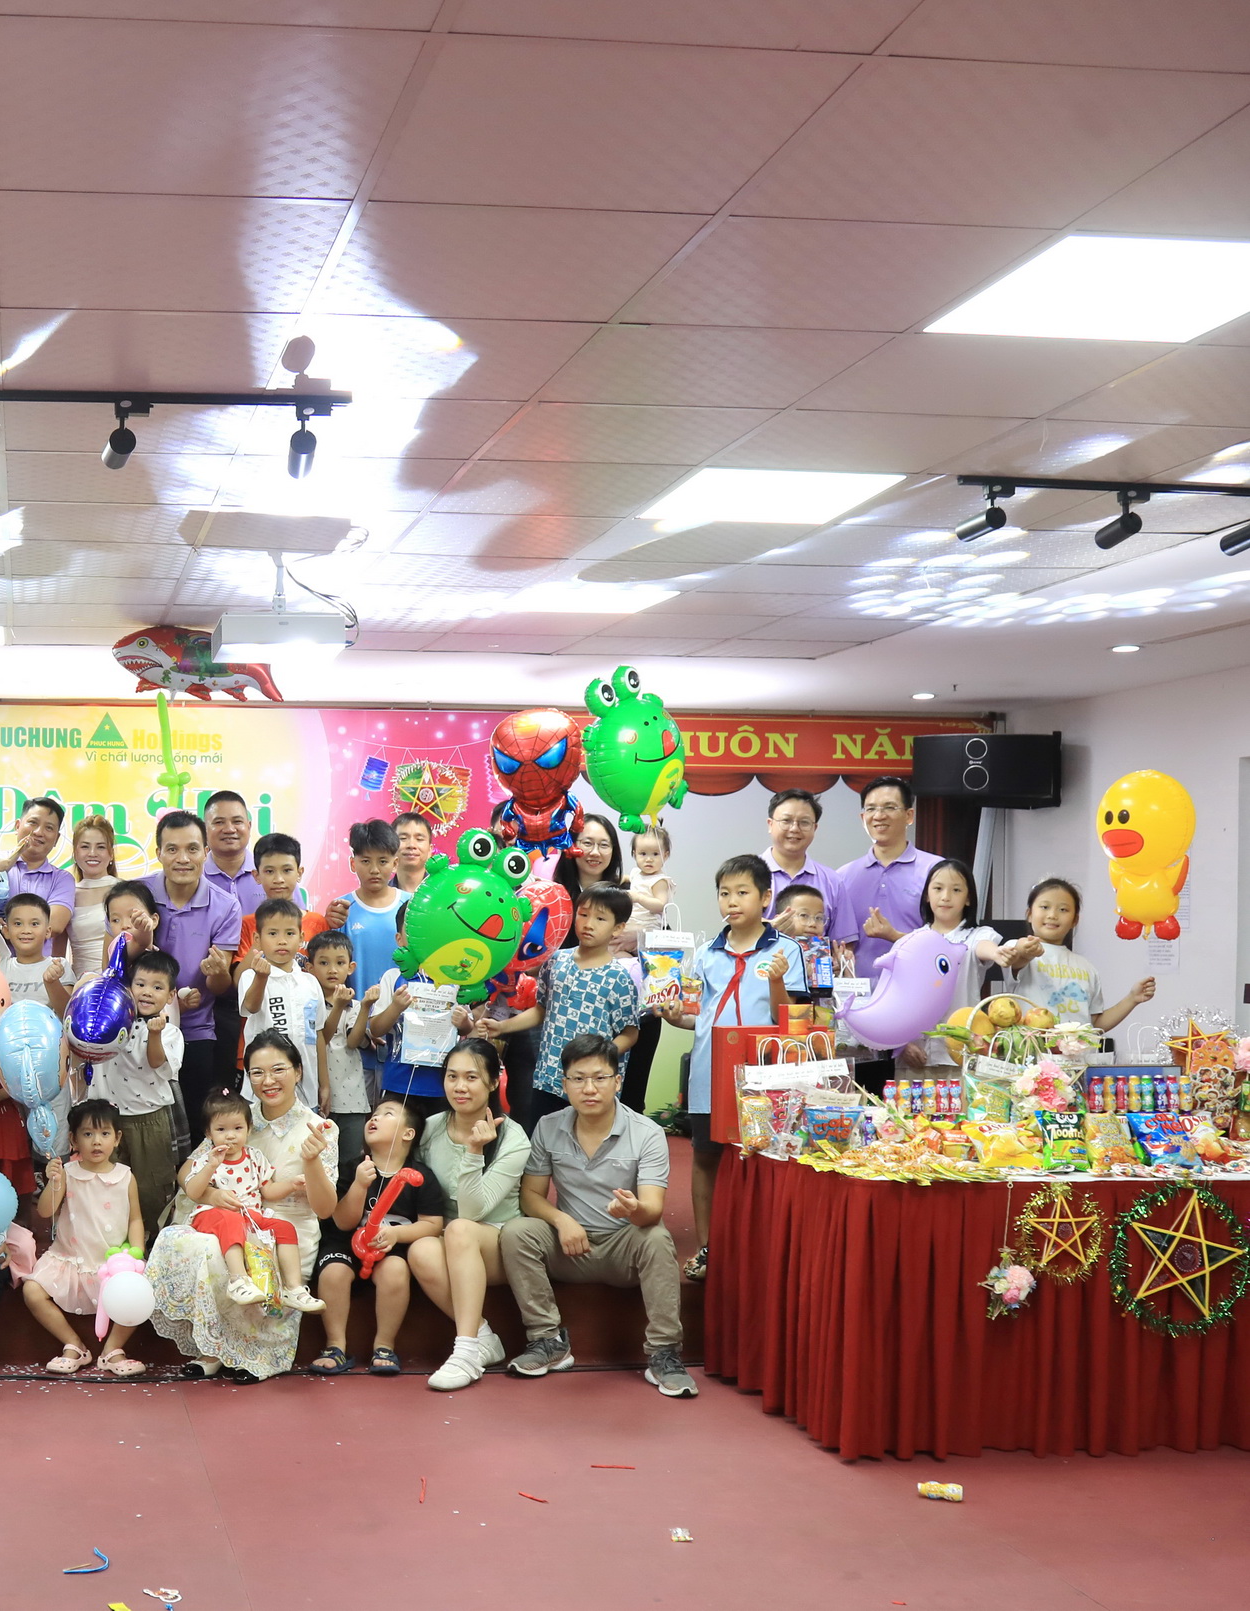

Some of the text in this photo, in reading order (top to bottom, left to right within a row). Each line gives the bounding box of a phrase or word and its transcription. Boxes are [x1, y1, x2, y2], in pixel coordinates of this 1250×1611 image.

[85, 751, 97, 762] Vì
[100, 750, 127, 762] chất
[173, 752, 197, 765] ống
[200, 752, 223, 763] mới
